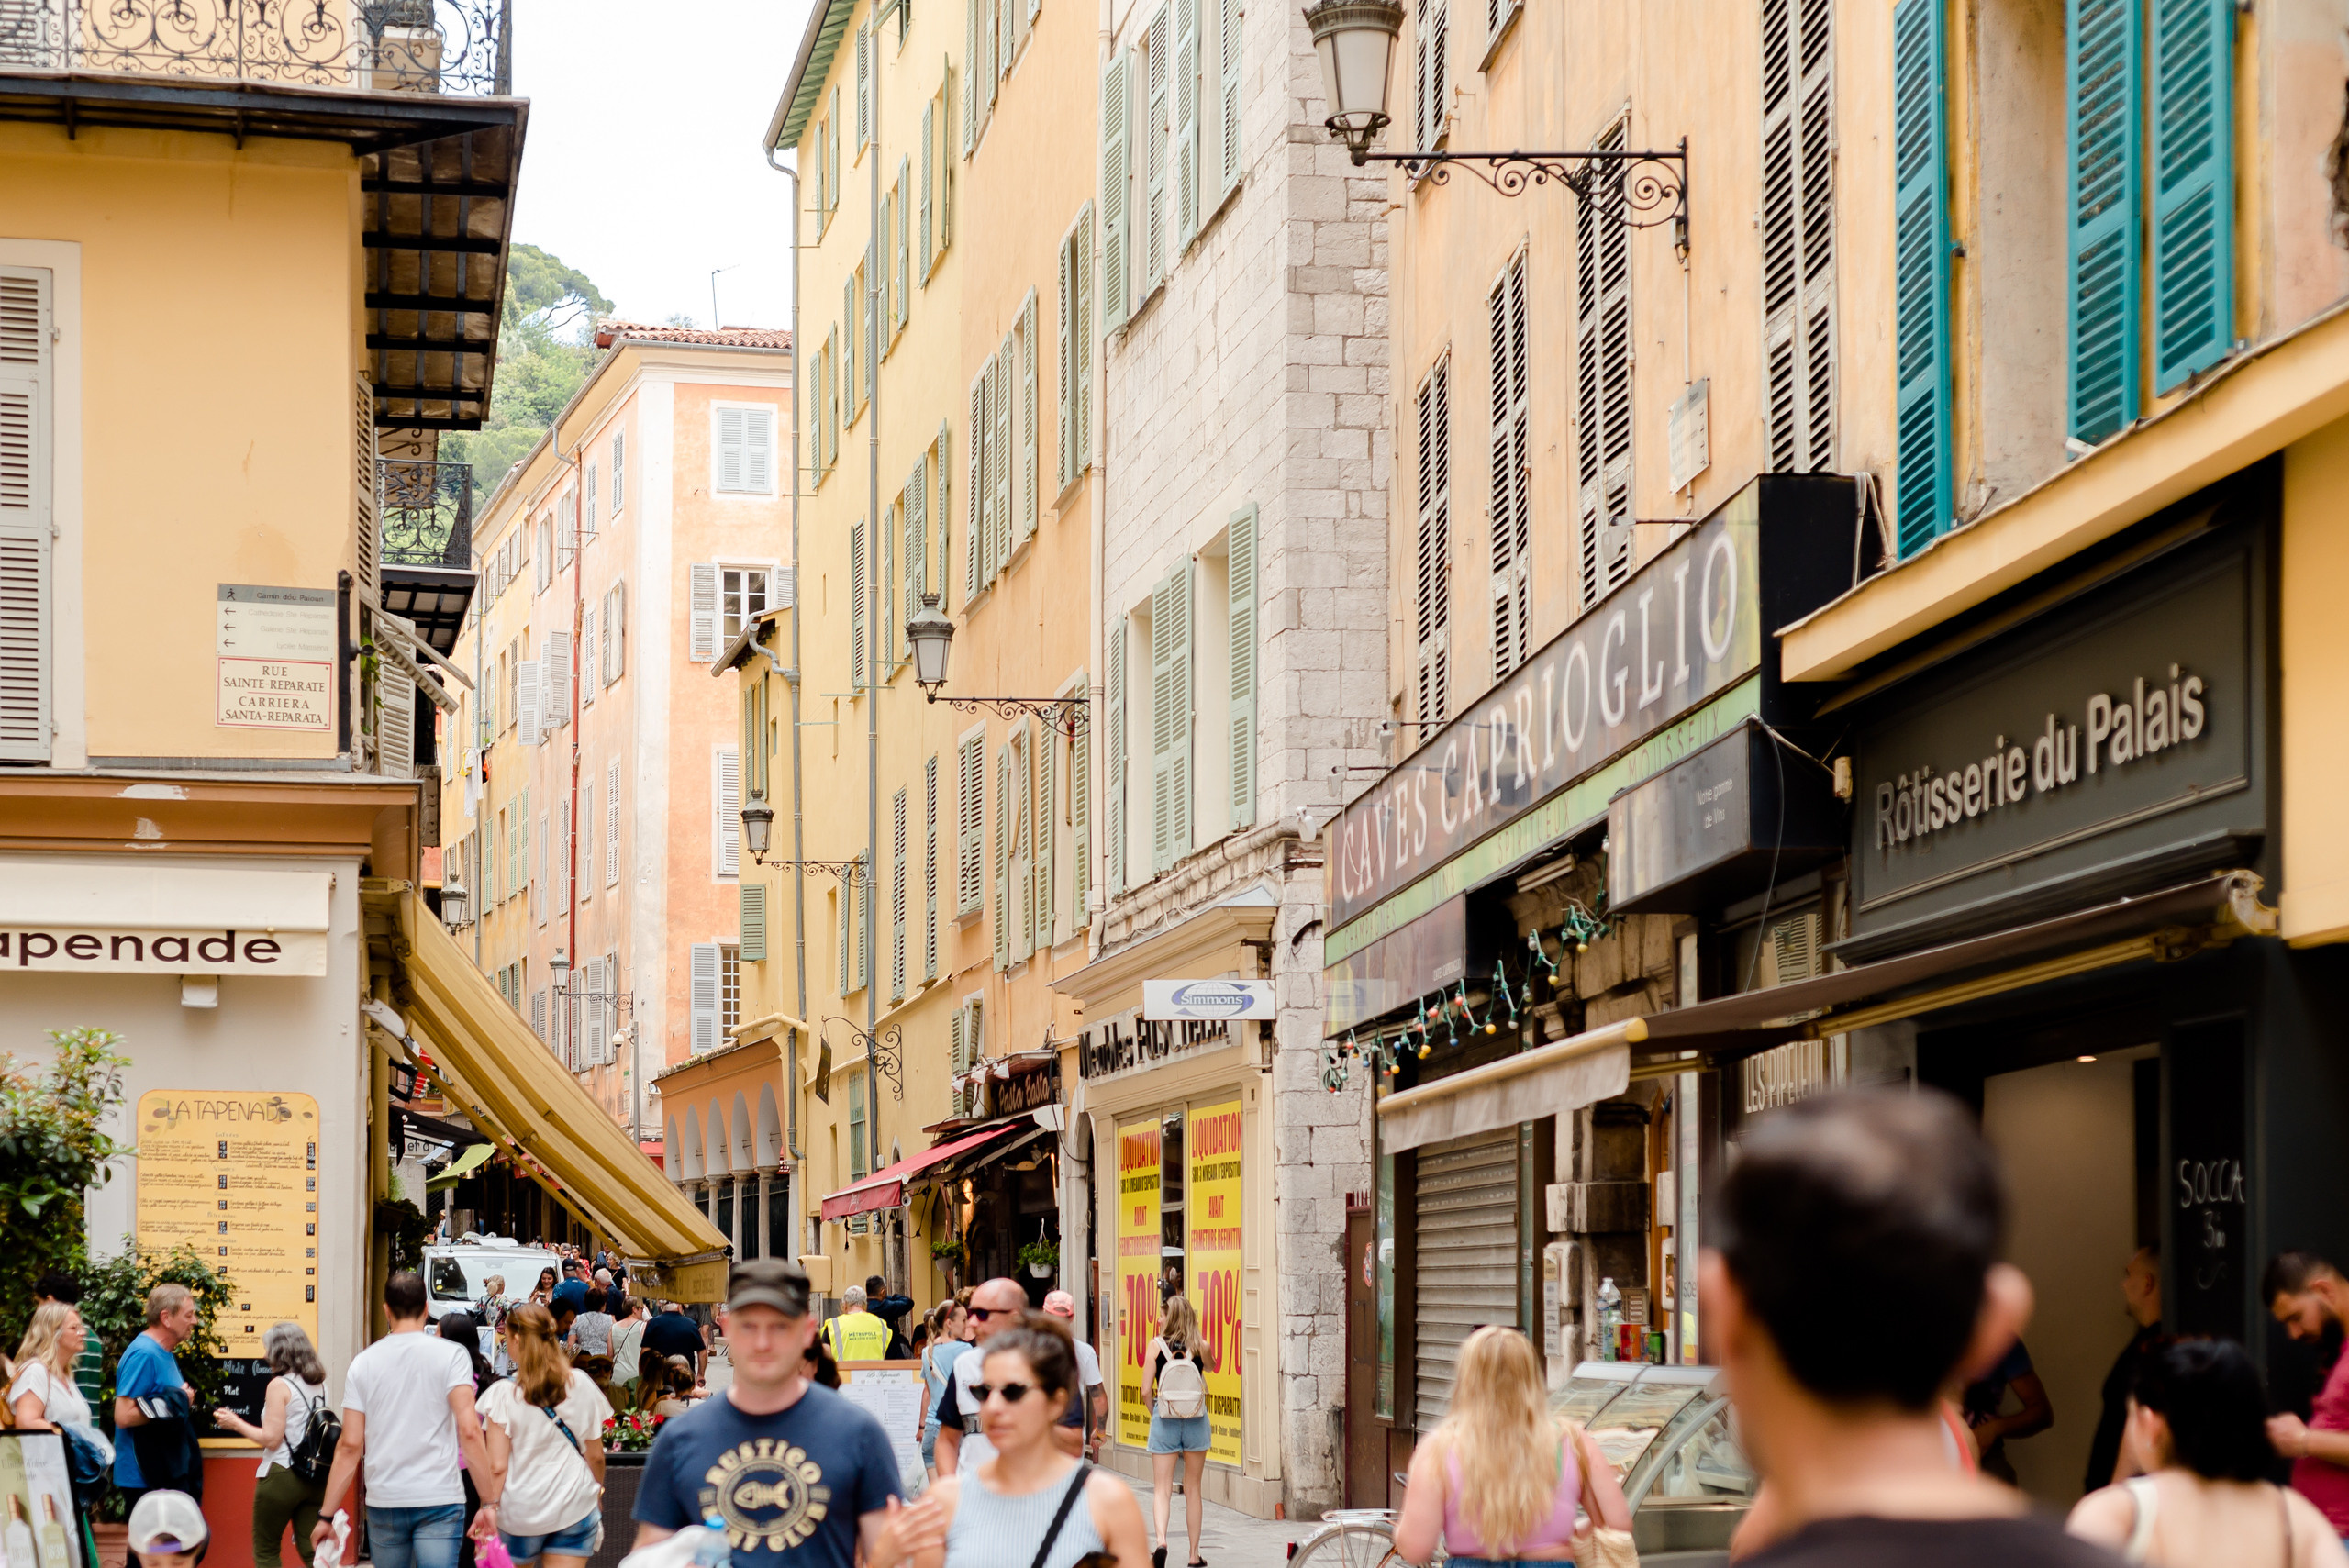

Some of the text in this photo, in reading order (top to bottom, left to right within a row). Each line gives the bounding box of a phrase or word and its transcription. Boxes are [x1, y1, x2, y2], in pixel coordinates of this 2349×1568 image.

[262, 665, 288, 676] RUE
[223, 676, 325, 693] SAINTE-REPARATE
[239, 695, 310, 709] CARRIERA
[225, 708, 323, 724] SANTA-REPARATA
[1341, 529, 1739, 904] CAVES CAPRIOGLIO
[1875, 662, 2205, 851] Rôtisserie du Palais
[1497, 795, 1570, 865] SPIRITUEUX
[1628, 703, 1720, 783] MOUSSEUX
[1704, 807, 1726, 828] de Vins
[0, 929, 282, 967] penade
[1180, 994, 1243, 1006] Simmons
[1078, 1021, 1134, 1081] Meubles
[998, 1070, 1051, 1116] Pasta Basta
[1744, 1051, 1765, 1114] LES
[166, 1100, 289, 1123] LA TAPENADE
[1191, 1111, 1242, 1162] LIQUIDATION
[2179, 1158, 2246, 1208] SOCCA
[1133, 1205, 1148, 1226] AVANT
[1208, 1195, 1225, 1218] AVANT
[1191, 1228, 1217, 1251] FERMETURE
[223, 1385, 239, 1396] Plat
[1213, 1395, 1242, 1418] DISPARAITR
[705, 1437, 822, 1487] RUSTICO
